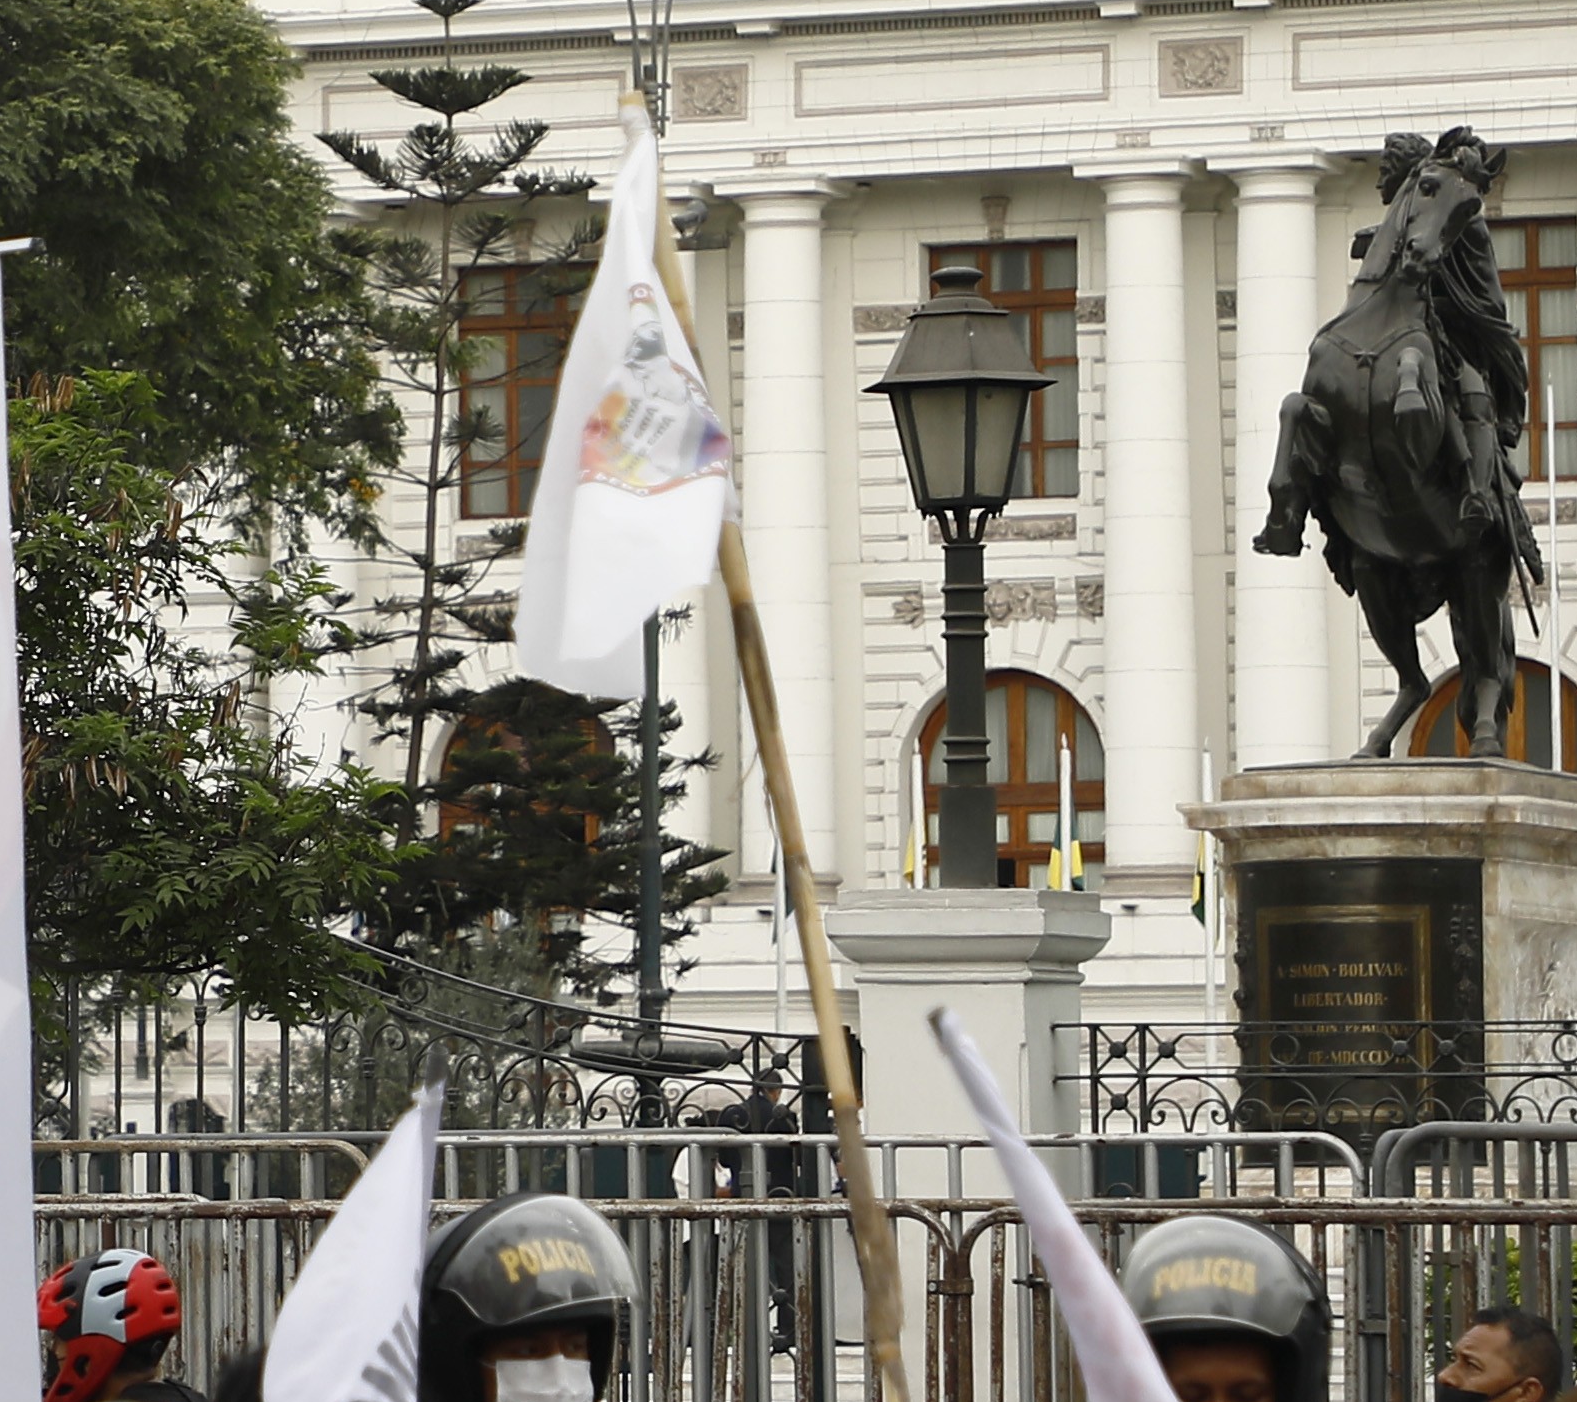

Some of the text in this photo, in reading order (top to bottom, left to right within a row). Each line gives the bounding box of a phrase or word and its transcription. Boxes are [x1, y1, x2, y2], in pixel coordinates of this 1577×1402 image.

[1338, 962, 1404, 978] BOLIVAR
[1293, 992, 1385, 1008] LIBERTADOR
[497, 1238, 596, 1283] POLICIA
[1153, 1256, 1258, 1298] POLICIA
